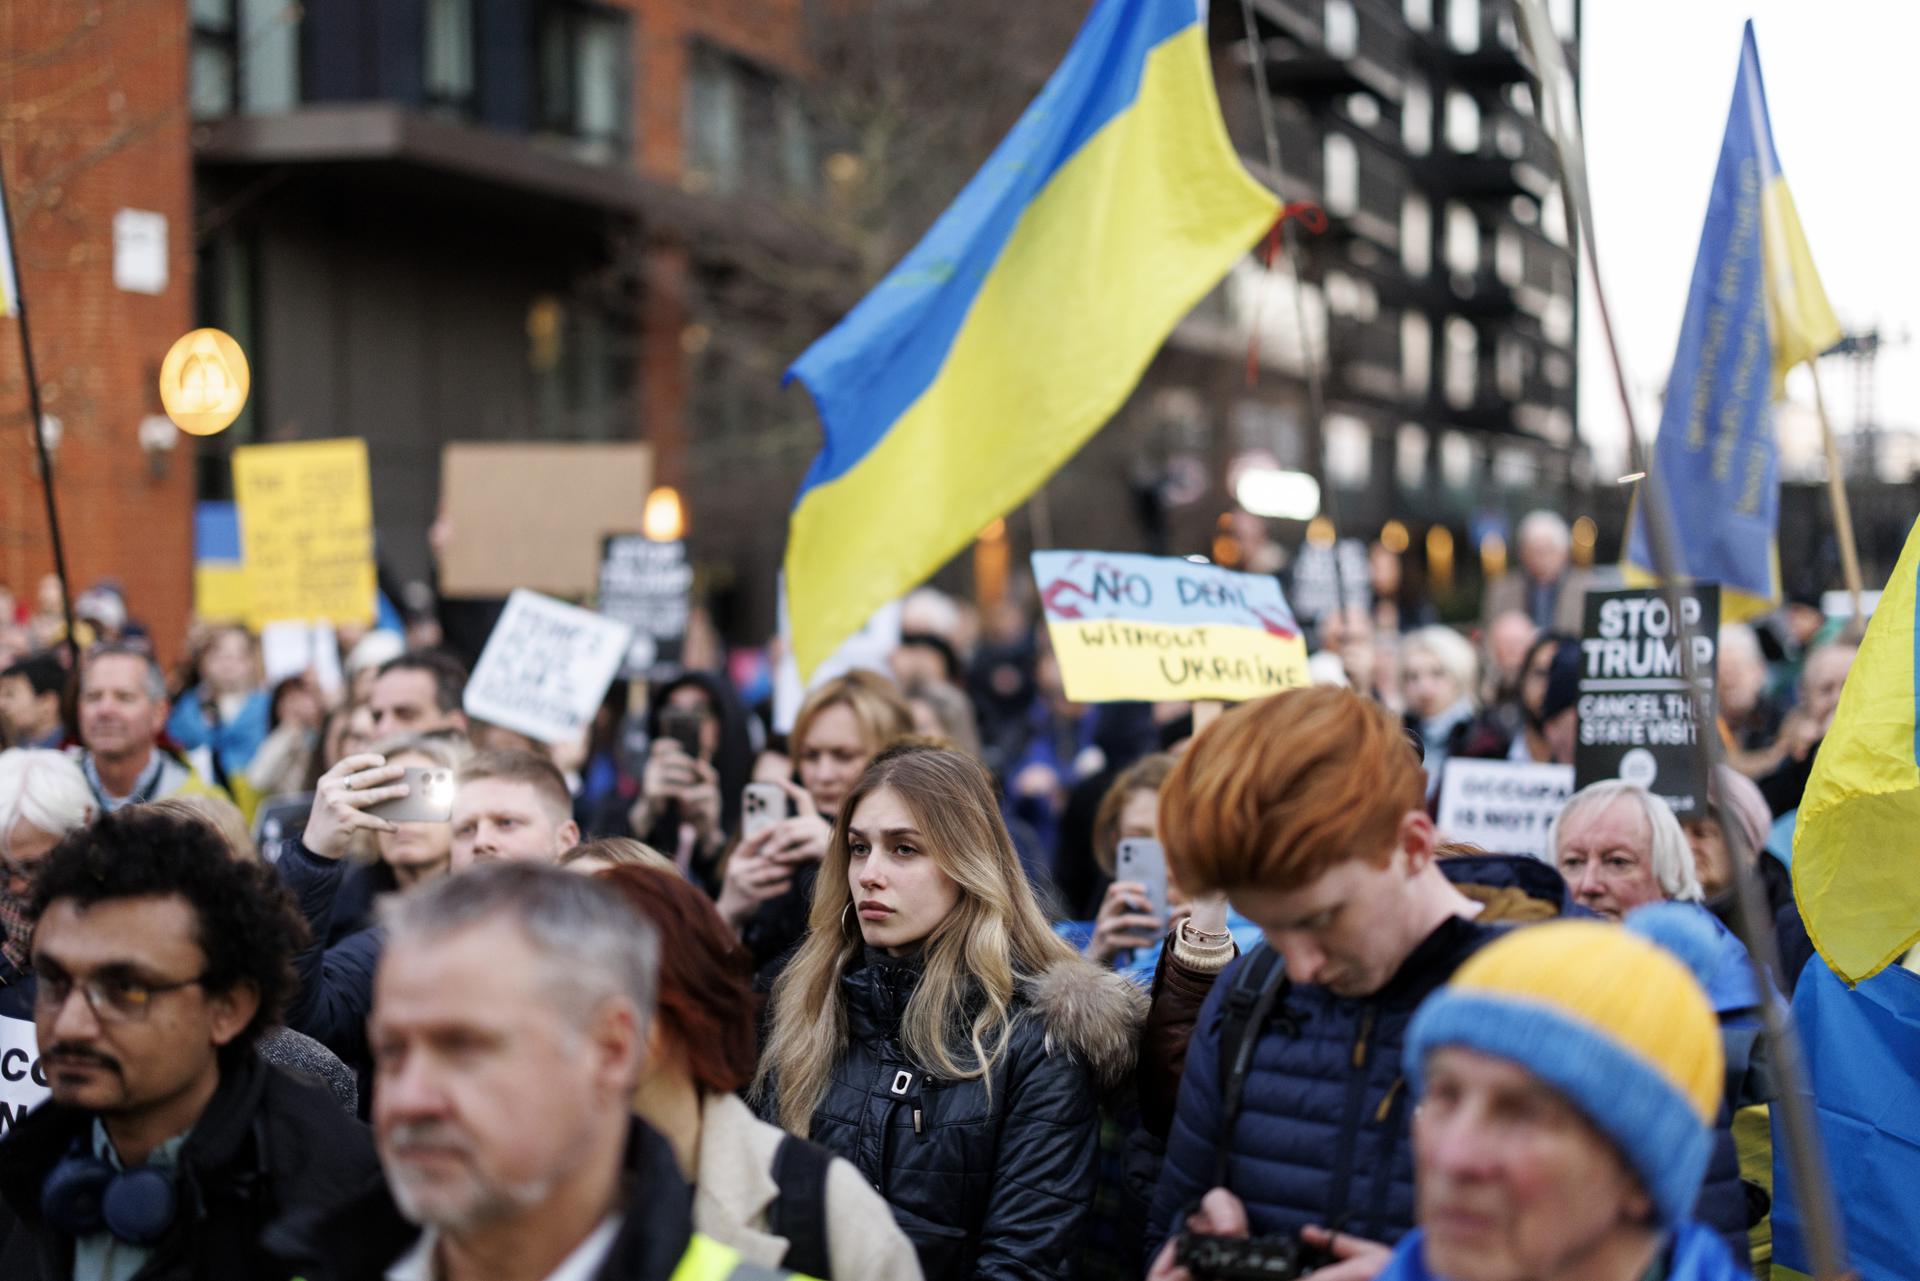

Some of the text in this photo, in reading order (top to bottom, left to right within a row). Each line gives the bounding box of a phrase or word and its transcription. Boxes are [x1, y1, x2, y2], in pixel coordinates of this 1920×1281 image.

[1091, 567, 1153, 609] NO
[1177, 575, 1249, 609] DEAL
[1598, 597, 1701, 639] STOP
[1582, 636, 1714, 678] TRUMP
[1577, 694, 1662, 721] CANCEL
[1580, 719, 1698, 746] STATE VISIT
[1484, 808, 1535, 832] NOT
